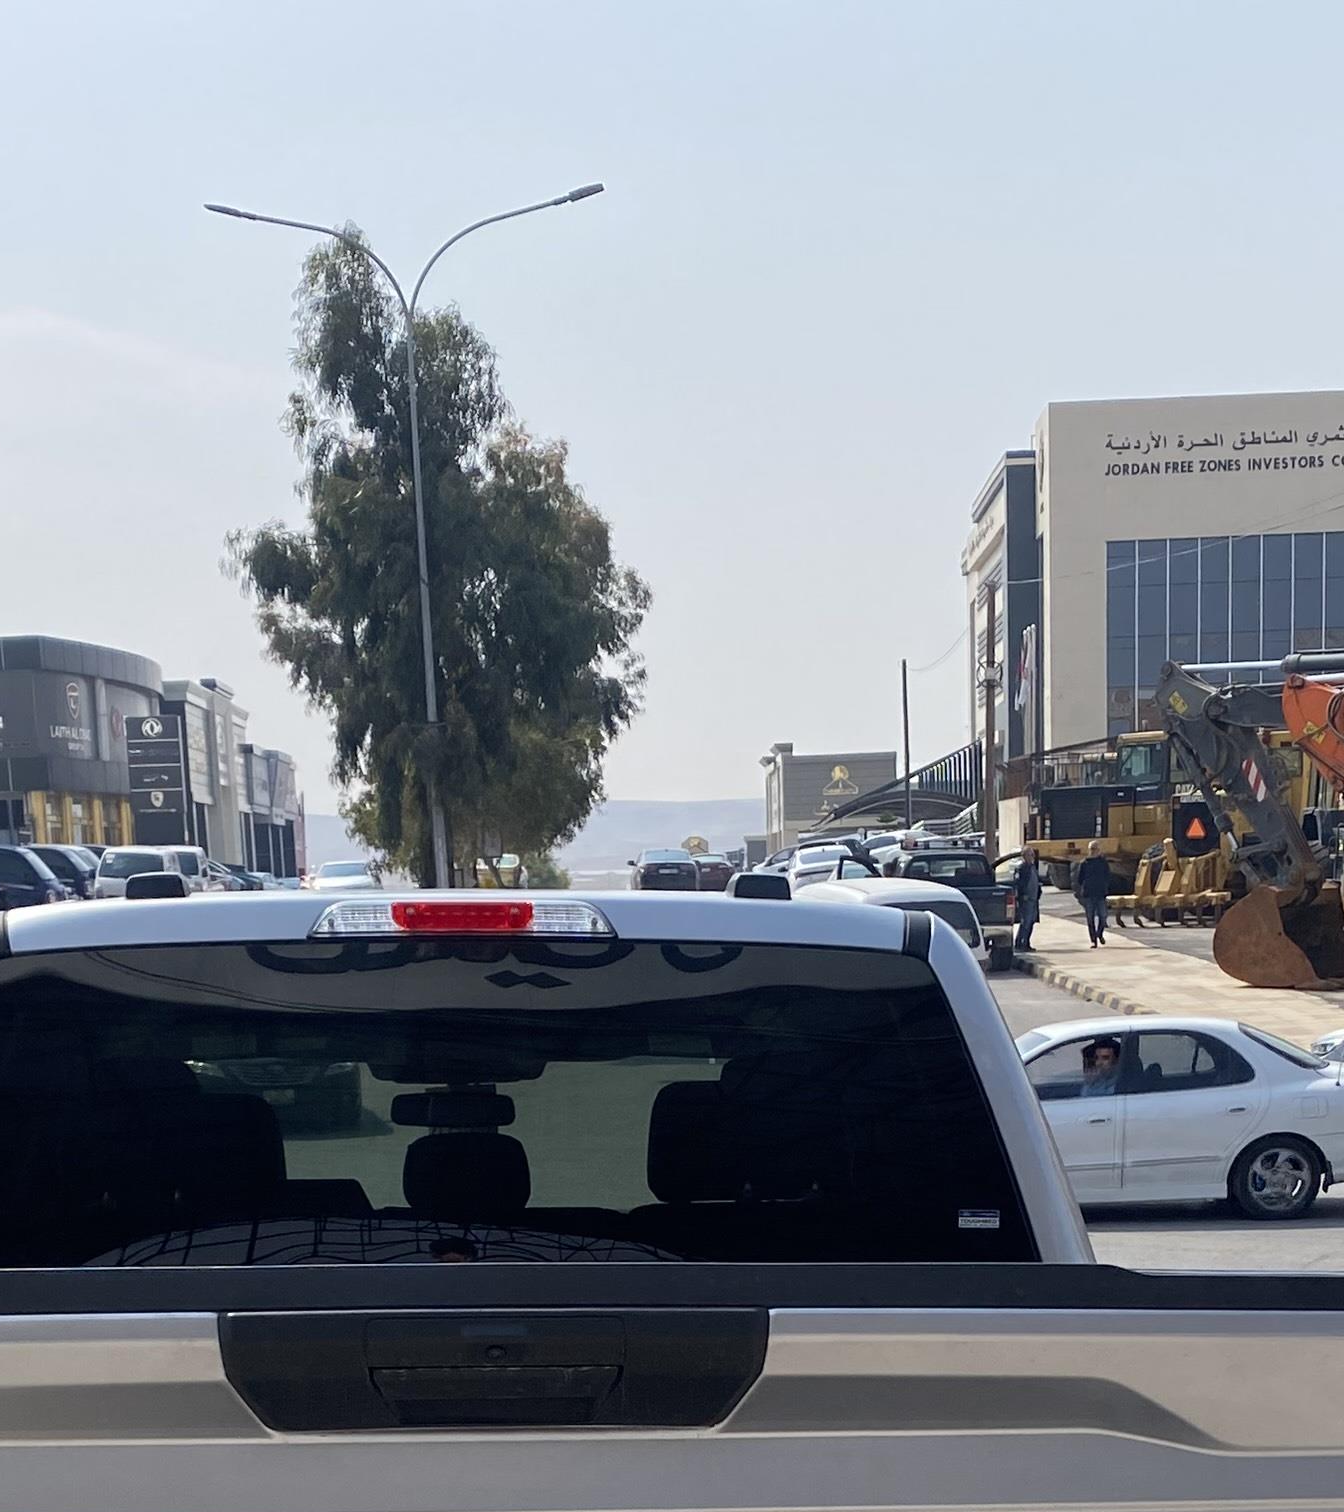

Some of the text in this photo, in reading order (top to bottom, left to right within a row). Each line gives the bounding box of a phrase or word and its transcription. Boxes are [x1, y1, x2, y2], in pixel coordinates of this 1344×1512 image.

[1105, 431, 1167, 455] الأردنية
[1176, 432, 1224, 451] الحرة
[1232, 429, 1298, 451] المناطق
[1105, 462, 1161, 476] JORDAN
[1164, 461, 1194, 474] FREE
[1199, 458, 1241, 473] ZONES
[1248, 455, 1324, 471] INVESTORS
